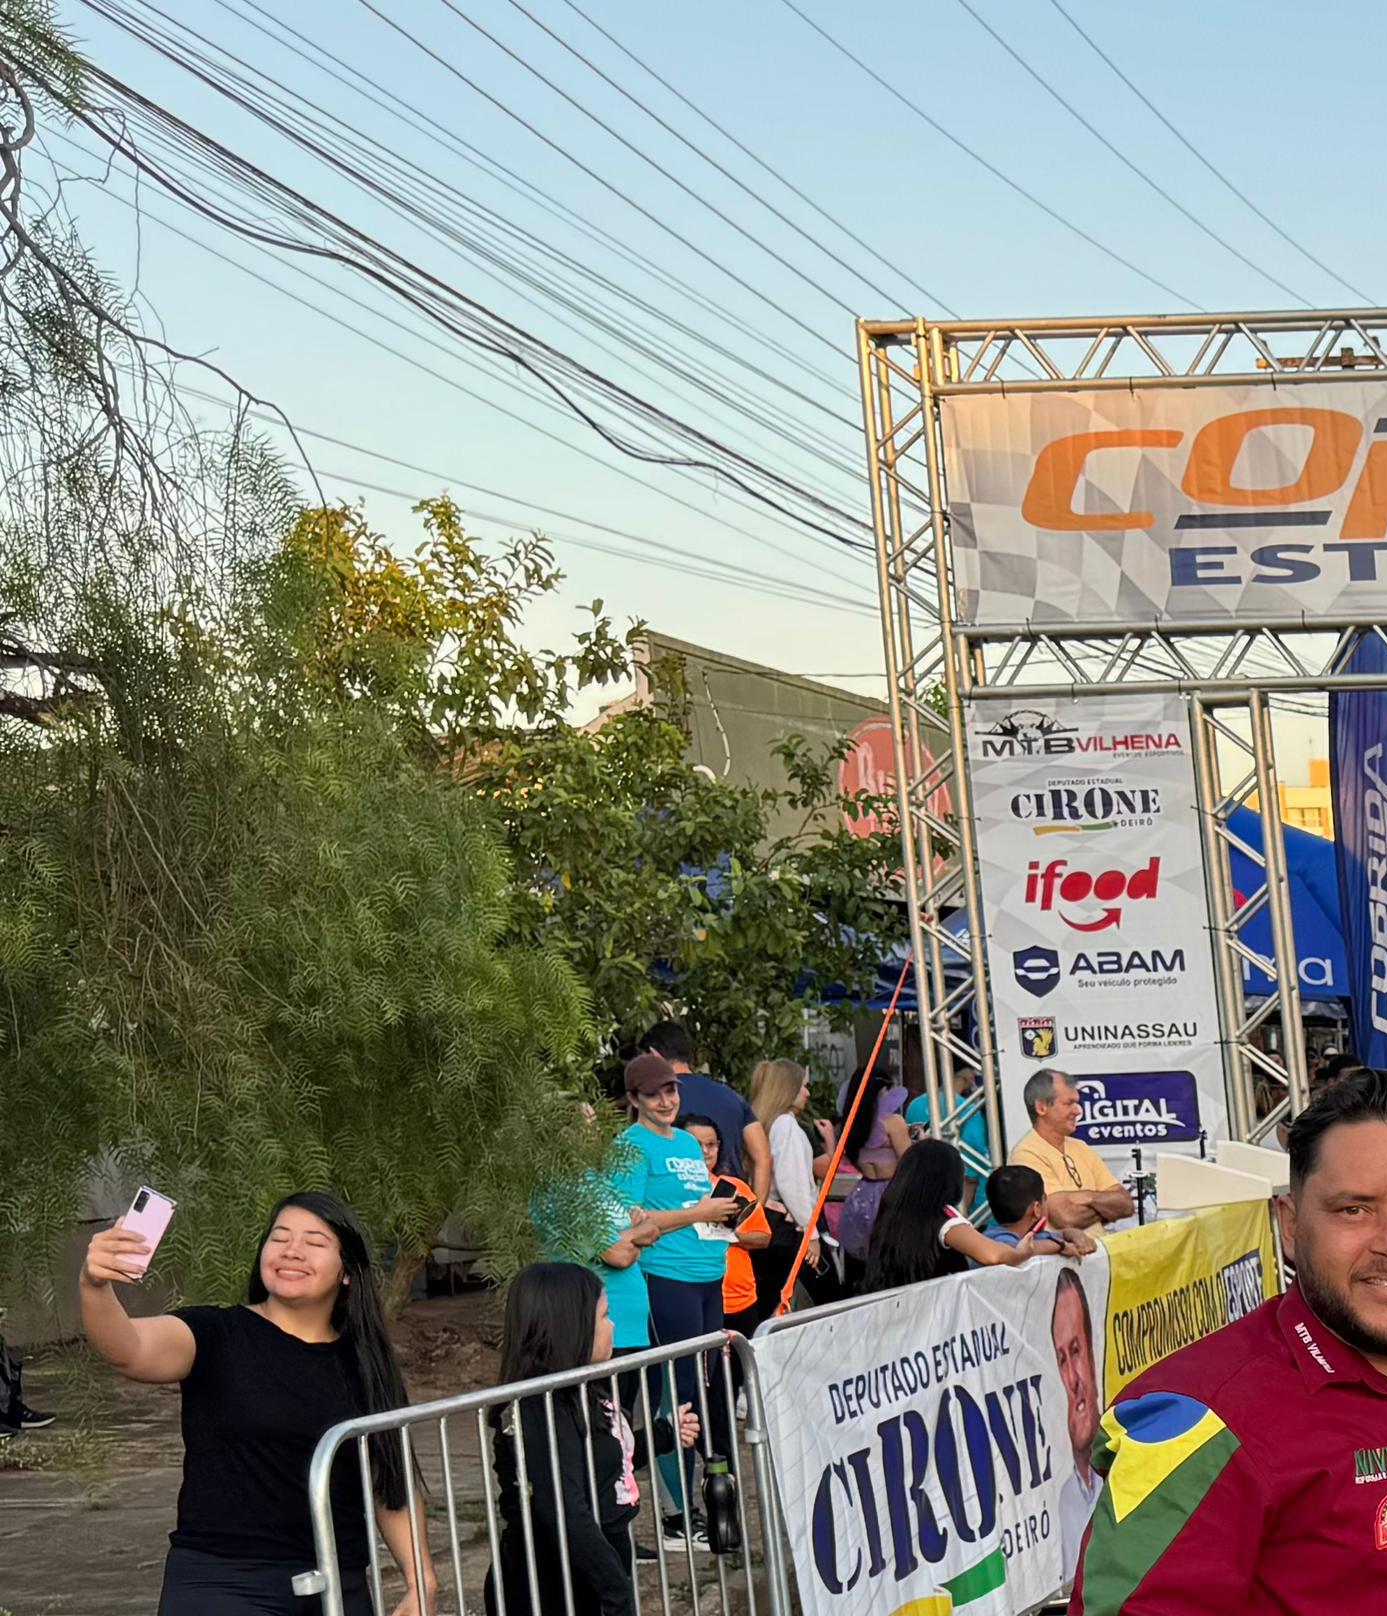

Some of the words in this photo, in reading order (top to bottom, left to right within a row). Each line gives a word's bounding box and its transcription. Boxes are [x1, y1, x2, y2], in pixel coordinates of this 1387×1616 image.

[982, 737, 1077, 757] MTB
[1076, 733, 1182, 752] VILHENA
[1048, 779, 1086, 787] DEPUTADO
[1087, 777, 1124, 785] ESTADUAL
[1010, 787, 1161, 821] CIRONE
[1120, 818, 1153, 828] DEIRÓ
[1069, 949, 1186, 976] ABAM
[1133, 976, 1178, 988] protegido
[1064, 1022, 1197, 1042] UNINASSAU
[1088, 1122, 1168, 1140] eventos
[1113, 1284, 1195, 1376] COMPROMISSO
[827, 1349, 930, 1426] DEPUTADO
[932, 1320, 1010, 1383] ESTADUAL
[811, 1373, 1052, 1596] CIRONE
[1002, 1501, 1051, 1562] DEIRÓ
